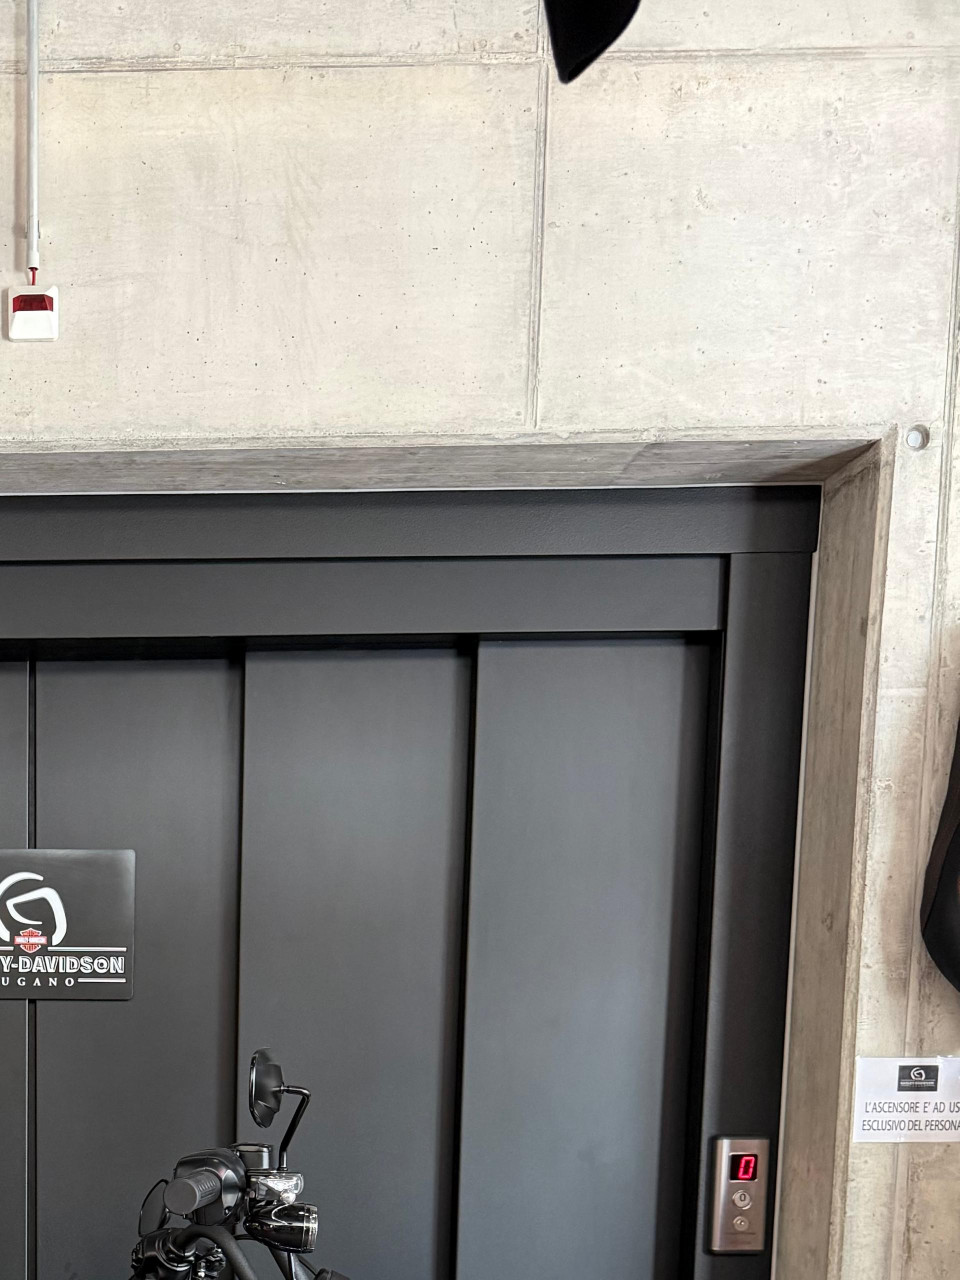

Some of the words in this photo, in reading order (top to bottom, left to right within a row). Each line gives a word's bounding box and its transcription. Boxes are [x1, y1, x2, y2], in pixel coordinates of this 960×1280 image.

[865, 1101, 920, 1114] L'ASCENSORE
[923, 1101, 931, 1114] E'
[932, 1101, 946, 1114] AD
[862, 1119, 907, 1131] ESCLUSIVO
[907, 1119, 923, 1131] DEL
[738, 1156, 755, 1179] 0
